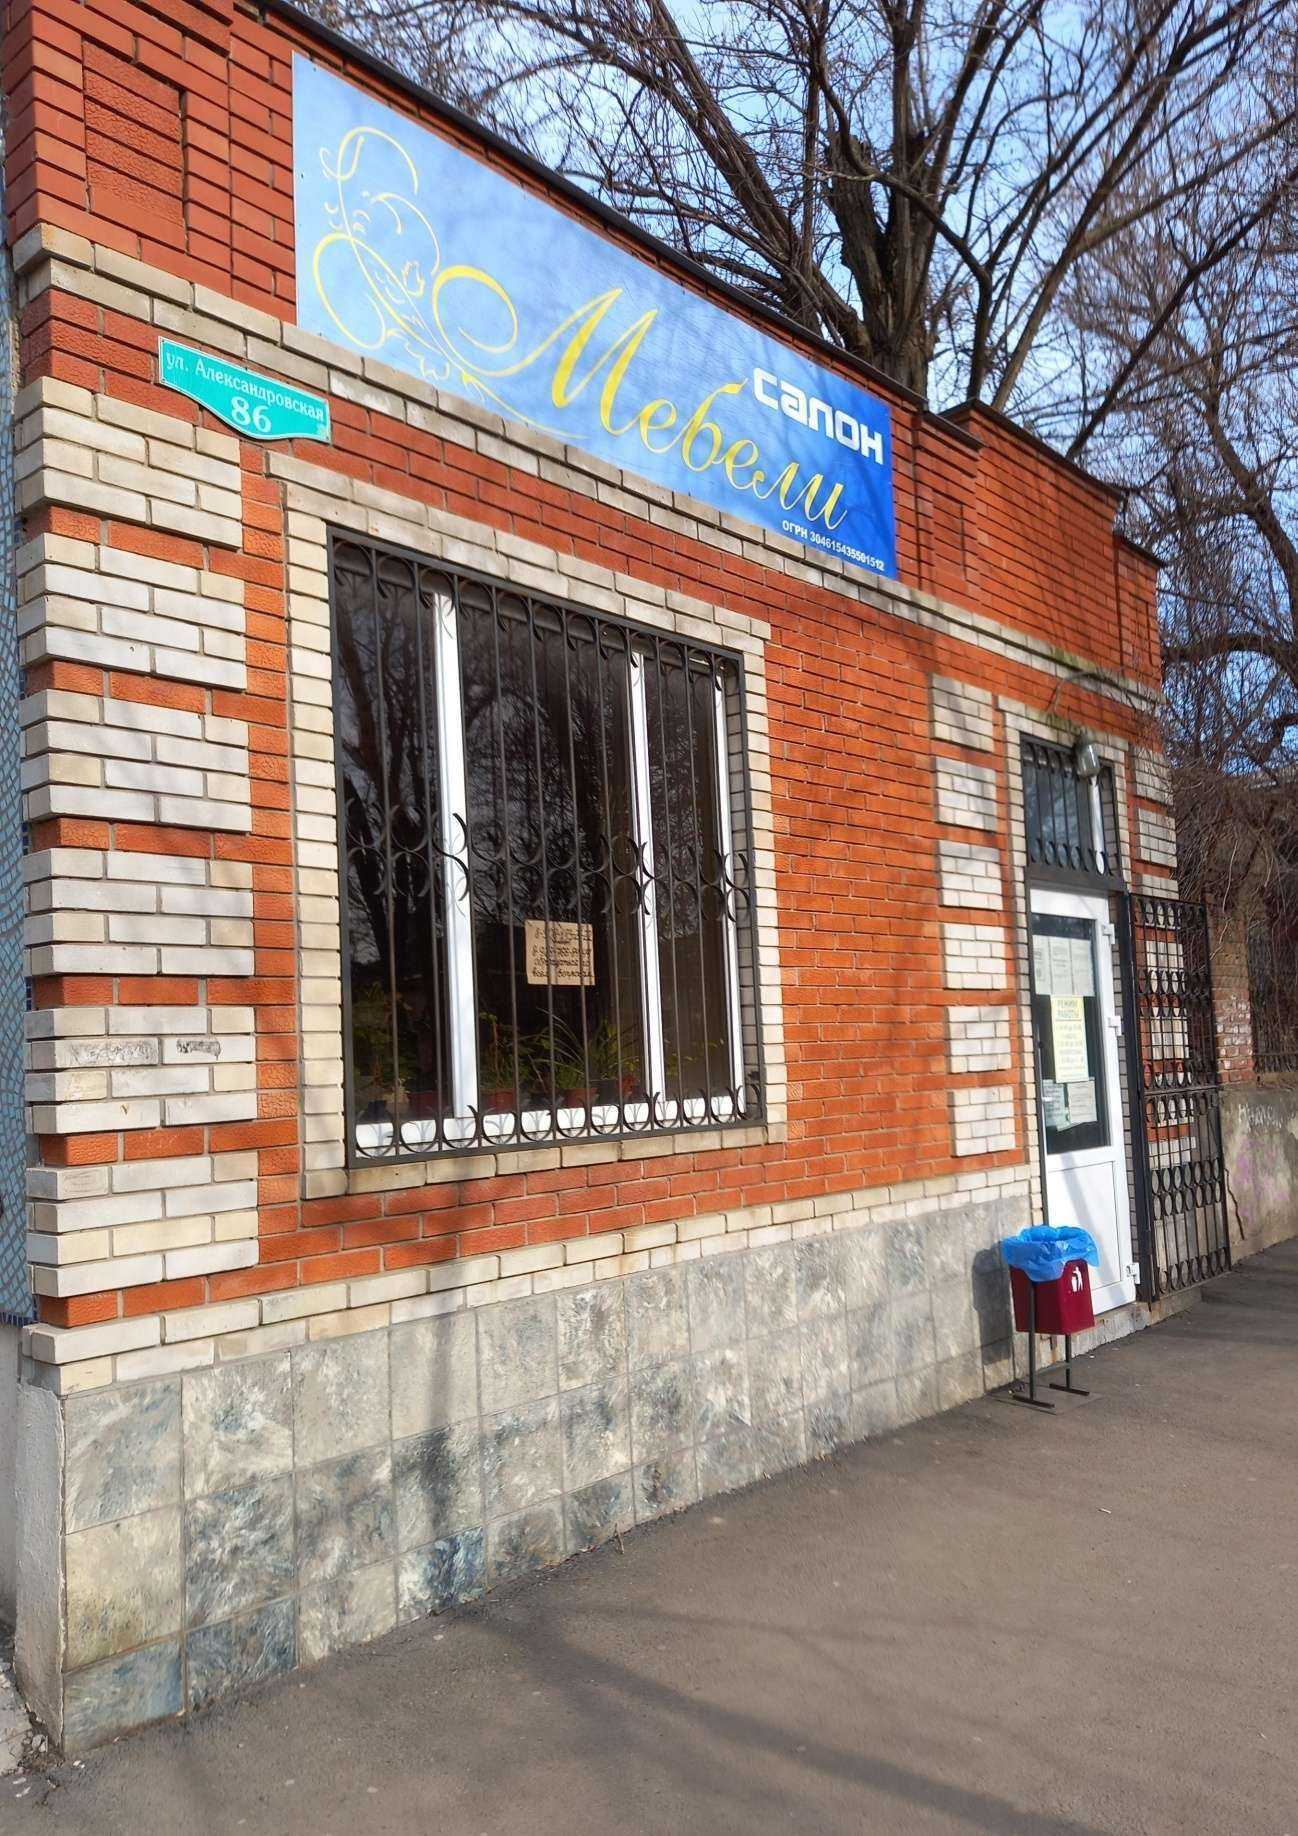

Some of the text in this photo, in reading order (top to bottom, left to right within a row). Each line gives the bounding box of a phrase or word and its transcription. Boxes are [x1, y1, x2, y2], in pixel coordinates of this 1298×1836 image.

[166, 352, 324, 421] ул. Александровская
[230, 396, 272, 433] 86
[432, 265, 848, 530] Мебели
[753, 367, 884, 465] салон
[782, 520, 808, 539] ОГРН
